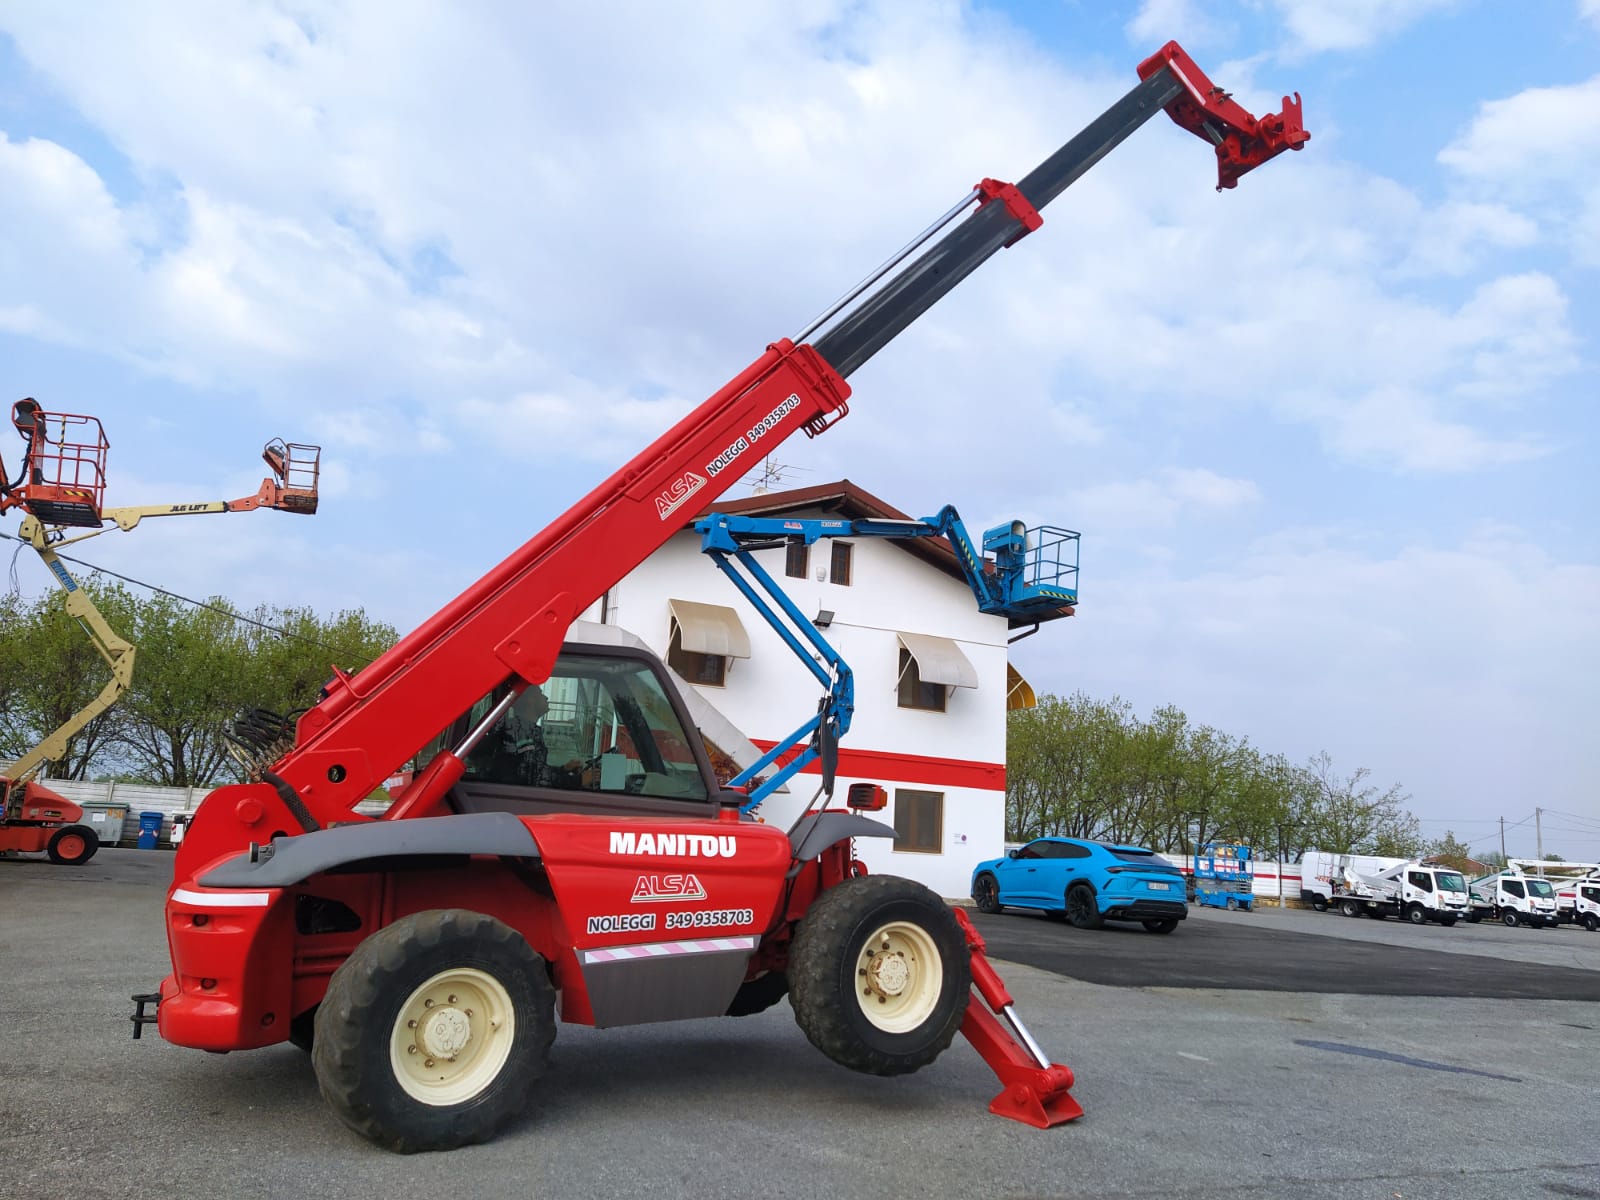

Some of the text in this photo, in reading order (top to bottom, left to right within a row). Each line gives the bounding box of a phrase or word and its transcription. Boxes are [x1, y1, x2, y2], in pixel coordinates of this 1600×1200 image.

[706, 437, 749, 477] NOLEGGI
[189, 503, 209, 511] LIFT
[654, 471, 704, 519] ALSA
[609, 832, 737, 858] MANITOU
[631, 874, 706, 901] ALSA
[588, 914, 656, 934] NOLEGGI
